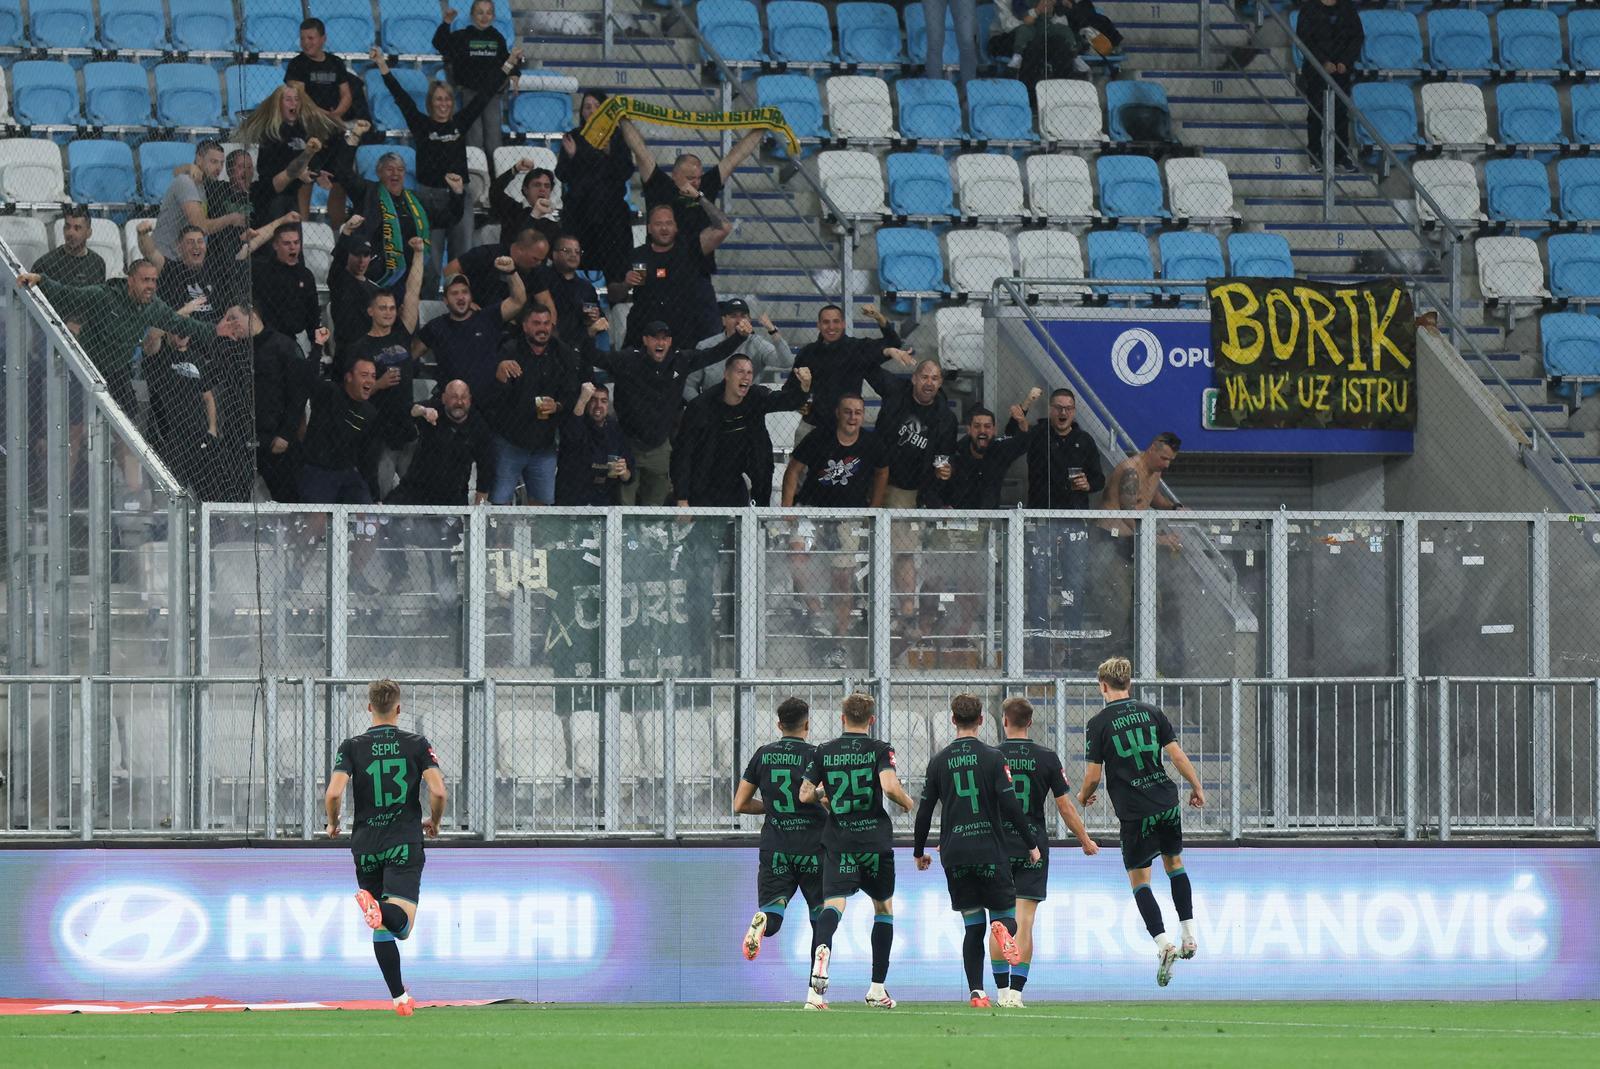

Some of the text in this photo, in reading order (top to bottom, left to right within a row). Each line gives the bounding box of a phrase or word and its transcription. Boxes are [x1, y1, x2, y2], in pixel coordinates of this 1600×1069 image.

[616, 70, 628, 84] 10
[1212, 80, 1223, 94] 10
[1274, 156, 1282, 170] 9
[1337, 232, 1344, 246] 8
[1211, 282, 1411, 371] BORIK
[1341, 377, 1408, 414] ISTRU
[1111, 711, 1151, 731] HRVATIN
[371, 740, 400, 756] ŠEPIĆ
[947, 754, 978, 769] KUMAR
[1111, 725, 1160, 771] 44
[365, 757, 409, 808] 13
[770, 768, 796, 814] 3
[827, 767, 874, 815] 25
[953, 769, 980, 815] 4
[227, 894, 593, 957] HYUNDAI
[924, 873, 1547, 957] KTROMANOVIĆ
